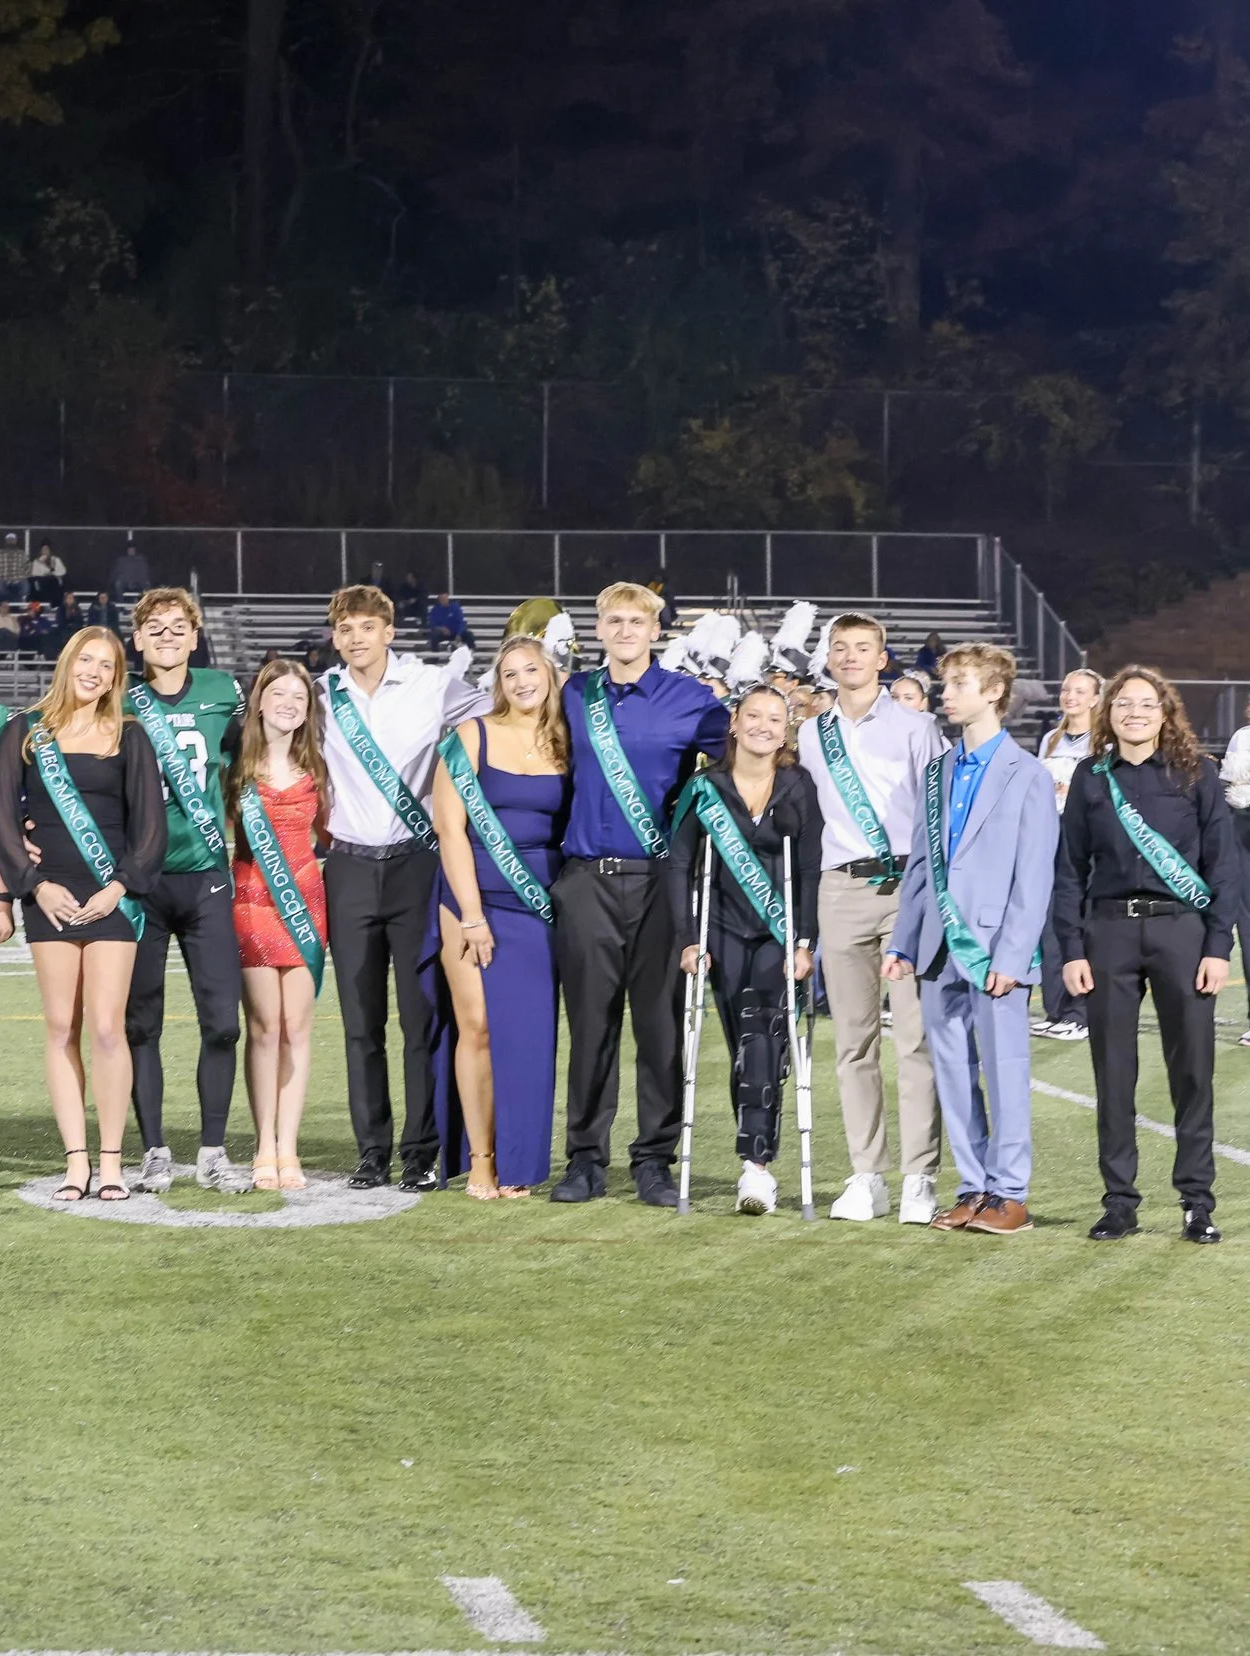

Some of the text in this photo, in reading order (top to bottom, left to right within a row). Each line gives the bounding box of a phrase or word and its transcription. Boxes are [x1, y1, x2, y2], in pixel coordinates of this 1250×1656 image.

[128, 684, 225, 852] HOMECOMING COURT
[337, 703, 412, 811] HOMECOMING
[589, 697, 670, 860] HOMECOMING COUR
[455, 771, 554, 923] HOMECOMING COU
[705, 801, 783, 918] HOMECOMING
[1118, 802, 1211, 909] HOMECOMING
[280, 888, 316, 944] COURT
